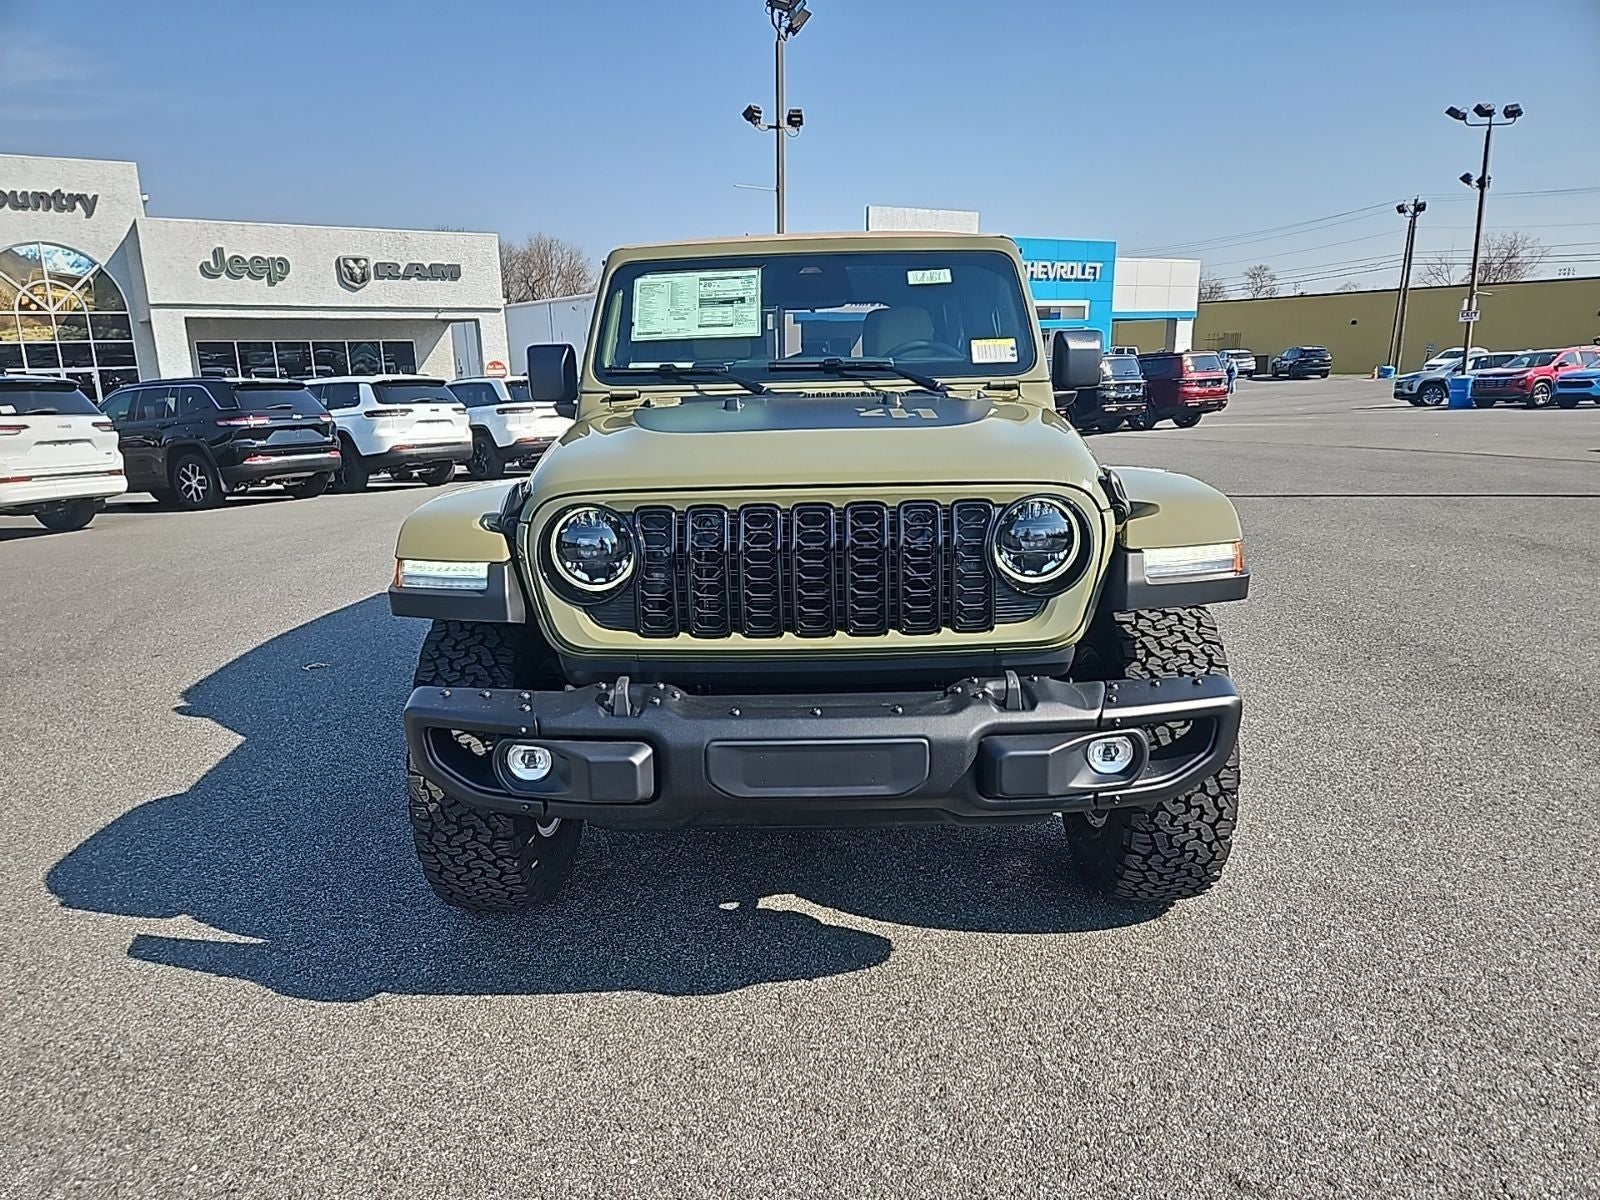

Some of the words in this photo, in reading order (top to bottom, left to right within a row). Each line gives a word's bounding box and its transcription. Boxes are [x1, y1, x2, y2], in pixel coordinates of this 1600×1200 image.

[199, 246, 290, 287] Jeep
[373, 262, 462, 281] RAM
[1022, 260, 1104, 281] HEVROLET
